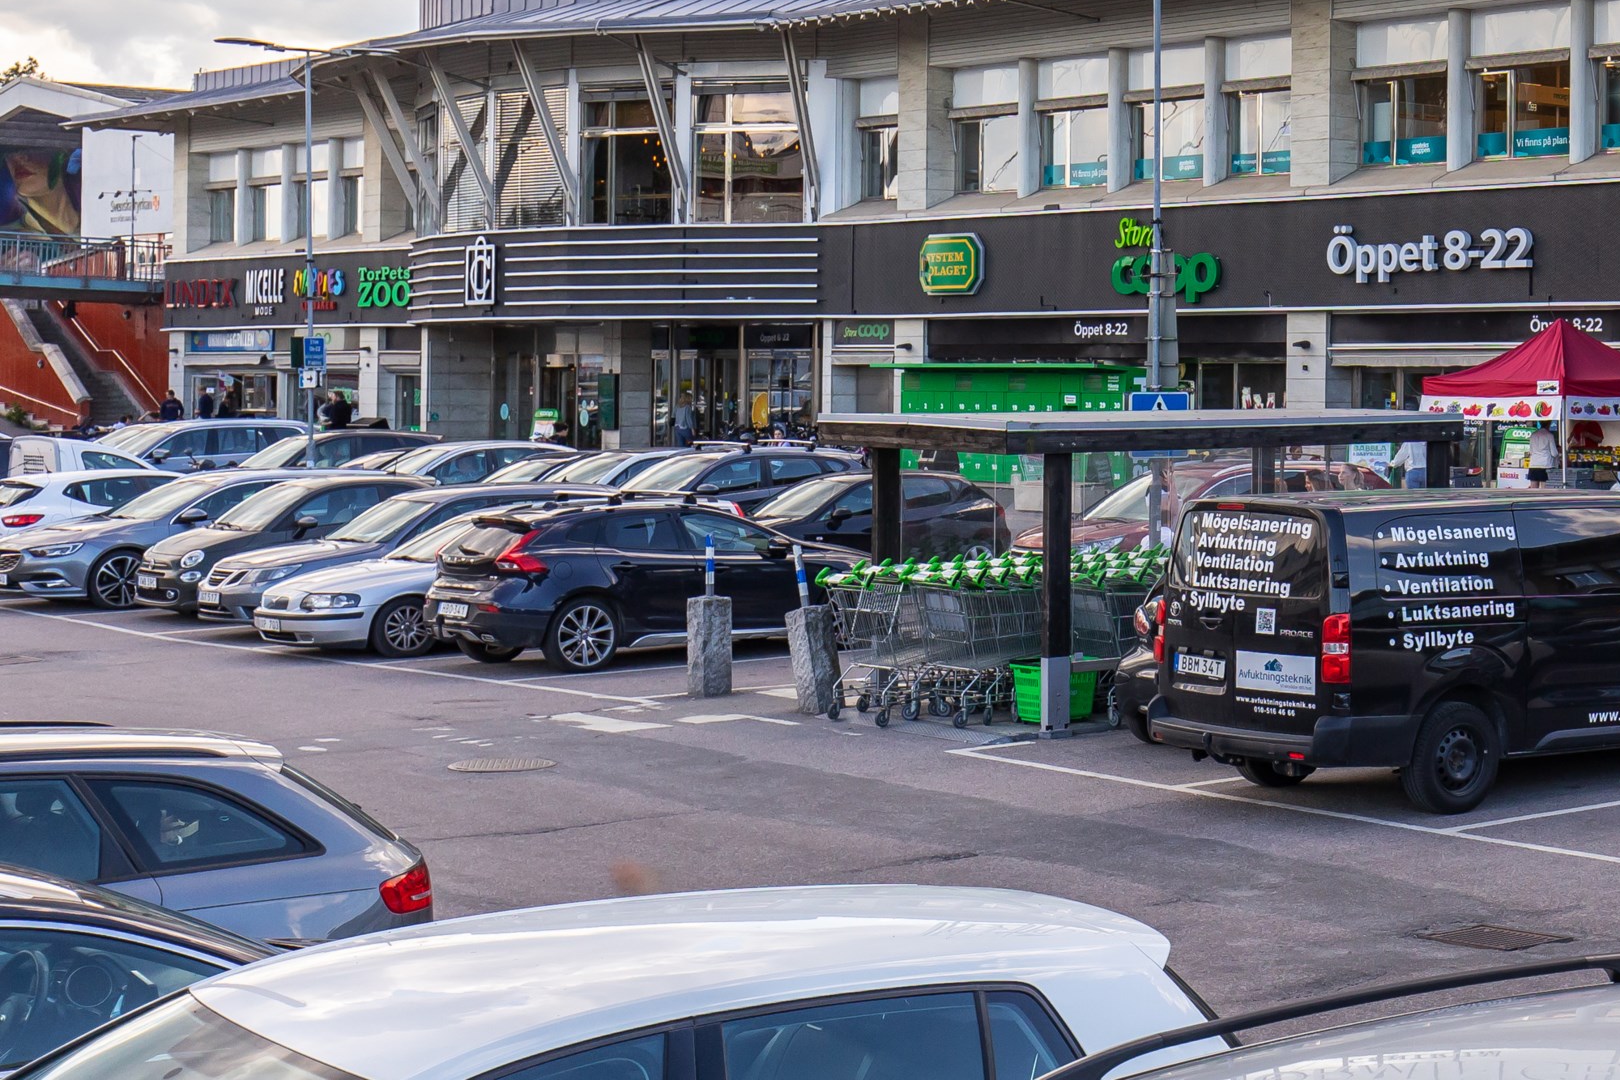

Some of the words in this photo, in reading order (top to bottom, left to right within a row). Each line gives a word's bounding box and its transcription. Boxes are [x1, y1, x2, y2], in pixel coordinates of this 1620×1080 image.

[1516, 138, 1524, 147] Vi
[1524, 137, 1542, 146] finns
[1543, 135, 1552, 148] på
[1552, 135, 1568, 147] plan
[926, 251, 964, 262] SYSTEM
[1326, 225, 1439, 283] Öppet
[1444, 227, 1534, 271] 8-22
[357, 265, 411, 281] TorPets
[924, 265, 967, 276] OLAGET
[164, 278, 235, 308] LINDEX
[245, 268, 284, 305] MICELLE
[357, 280, 411, 308] ZOO
[254, 306, 273, 315] MODE
[858, 324, 889, 340] coop
[1074, 321, 1103, 339] Öppet
[1105, 323, 1128, 336] 8-22
[1512, 429, 1532, 438] coop
[1201, 512, 1312, 539] Mögelsanering
[1391, 523, 1516, 545] Mögelsanering
[1198, 532, 1277, 556] Avfuktning
[1196, 551, 1274, 573] Ventilation
[1395, 550, 1489, 569] Avfuktning
[1193, 572, 1291, 597] Luktsanering
[1398, 575, 1494, 595] Ventilation
[1189, 590, 1246, 613] Syllbyte
[1401, 600, 1515, 622] Luktsanering
[1279, 629, 1314, 639] PROACE
[1403, 628, 1475, 652] Syllbyte
[1181, 656, 1200, 672] BBM
[1202, 659, 1222, 676] 34T
[1239, 668, 1312, 685] Avfuktningsteknik
[1236, 695, 1316, 710] www.avfuktningsteknik.se
[1278, 707, 1286, 716] 46
